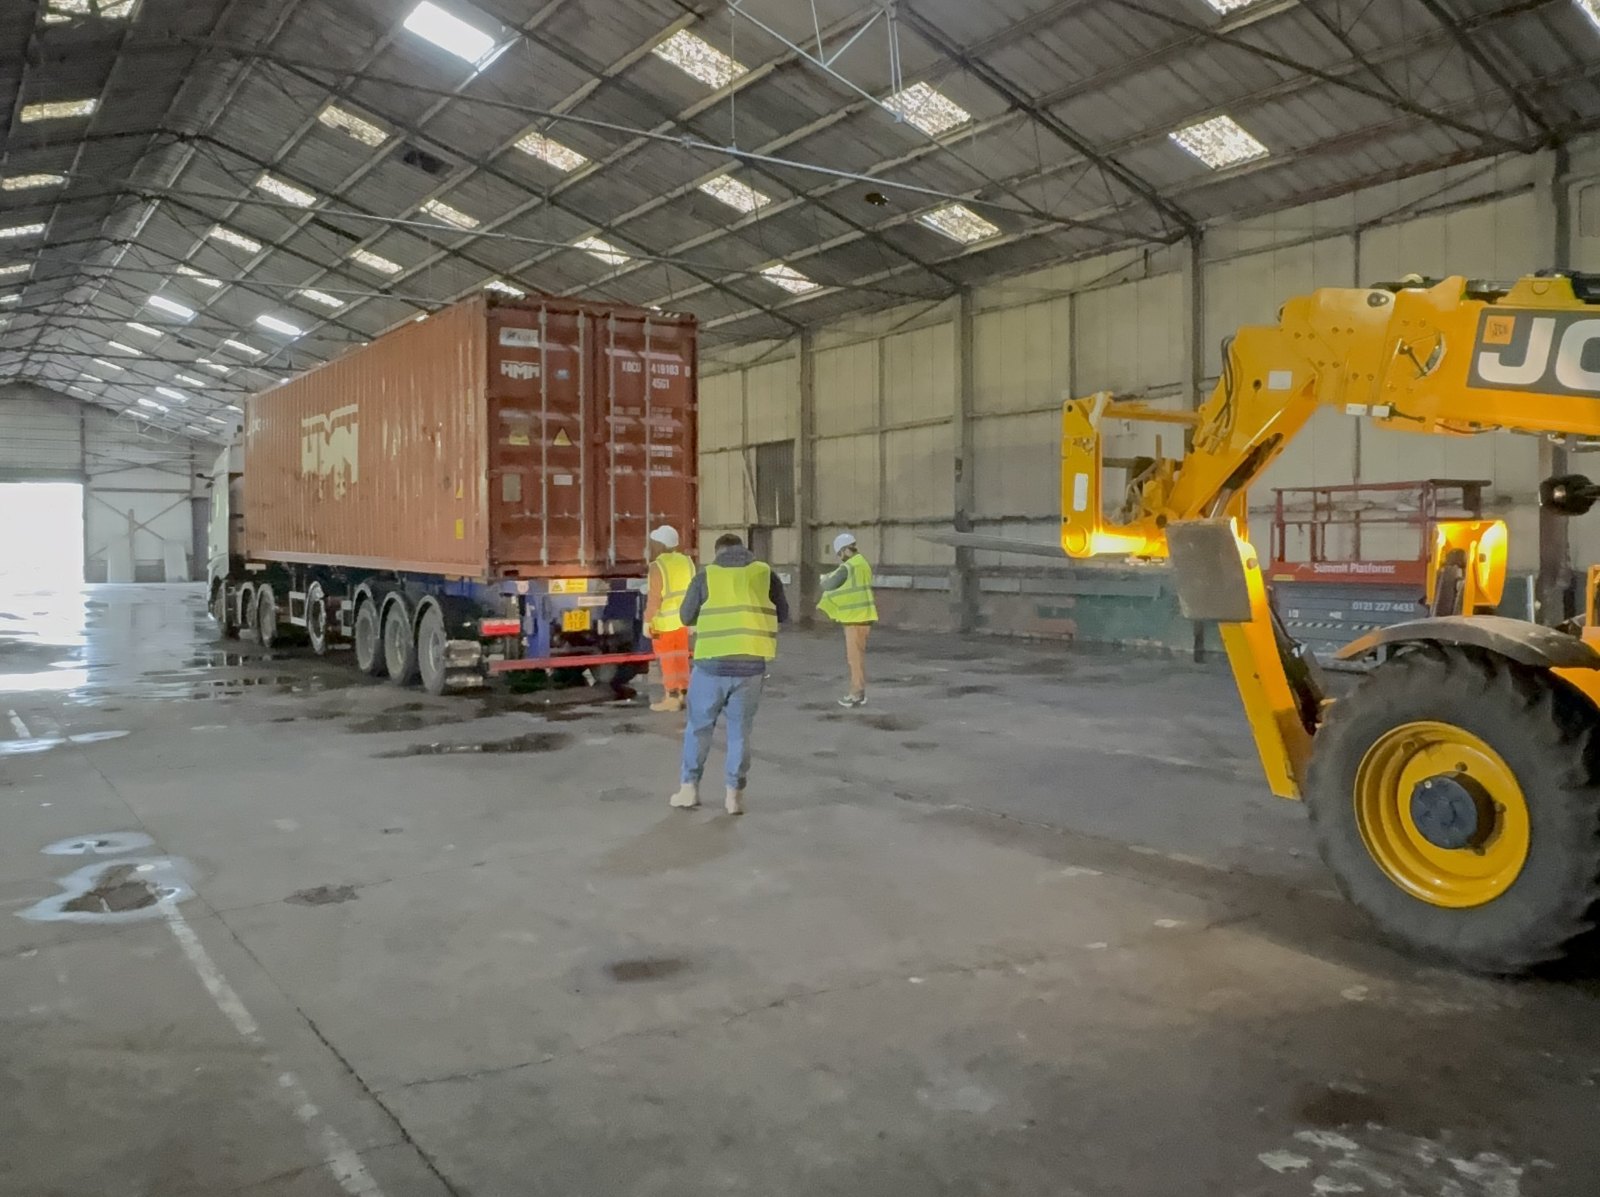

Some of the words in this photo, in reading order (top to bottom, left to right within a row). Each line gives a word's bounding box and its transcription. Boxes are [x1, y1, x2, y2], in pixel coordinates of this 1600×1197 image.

[501, 360, 540, 380] HMM
[1314, 563, 1348, 573] Summit
[1350, 562, 1396, 574] Platforms
